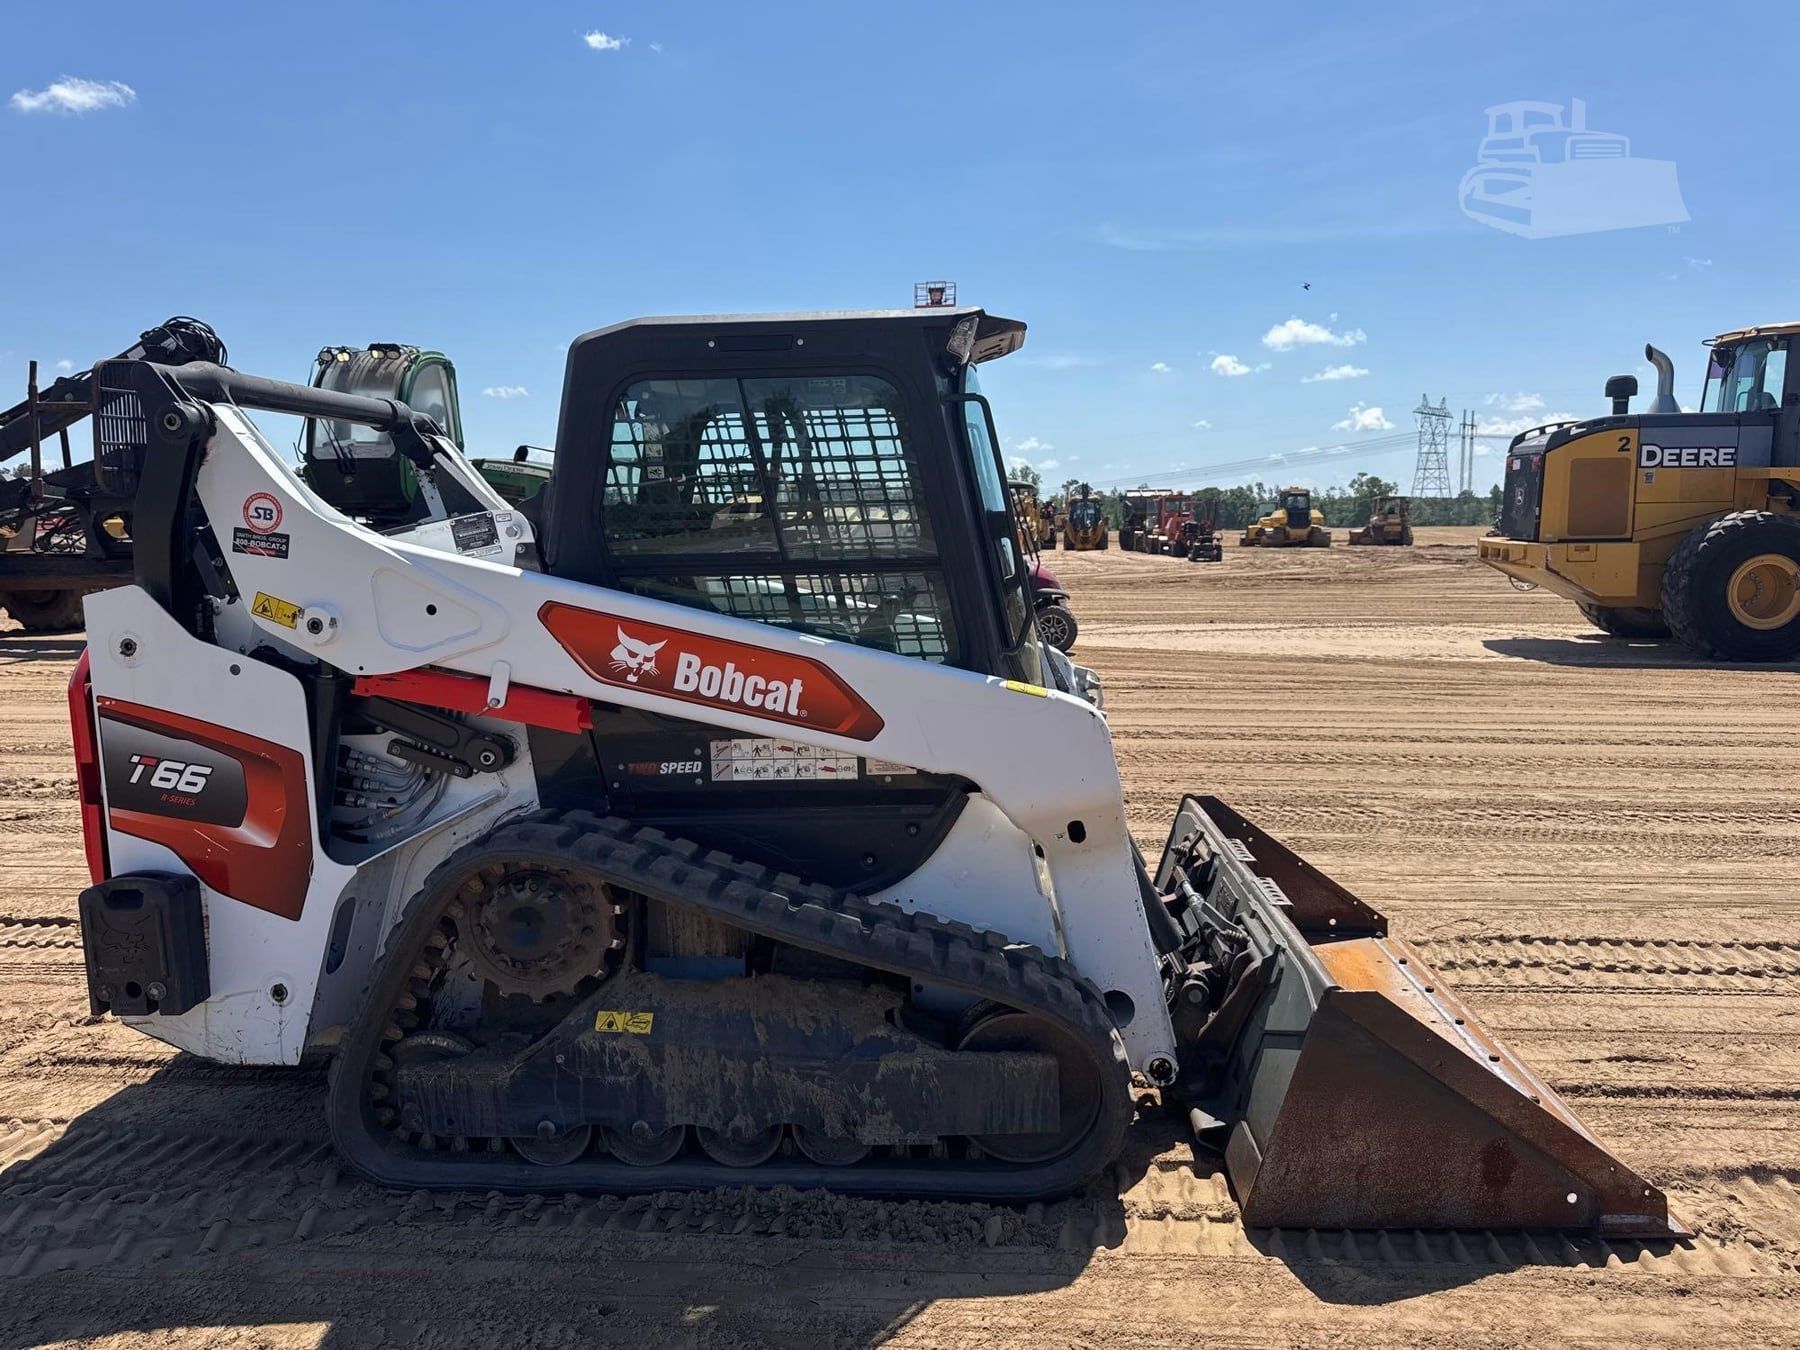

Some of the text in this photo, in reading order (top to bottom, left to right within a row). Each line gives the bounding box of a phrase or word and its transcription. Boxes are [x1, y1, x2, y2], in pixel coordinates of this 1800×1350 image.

[1617, 436, 1631, 452] 2
[1640, 444, 1736, 467] DEERE
[250, 506, 273, 521] SB
[673, 652, 803, 716] Bobcat
[129, 754, 213, 794] T66
[660, 761, 702, 774] SPEED
